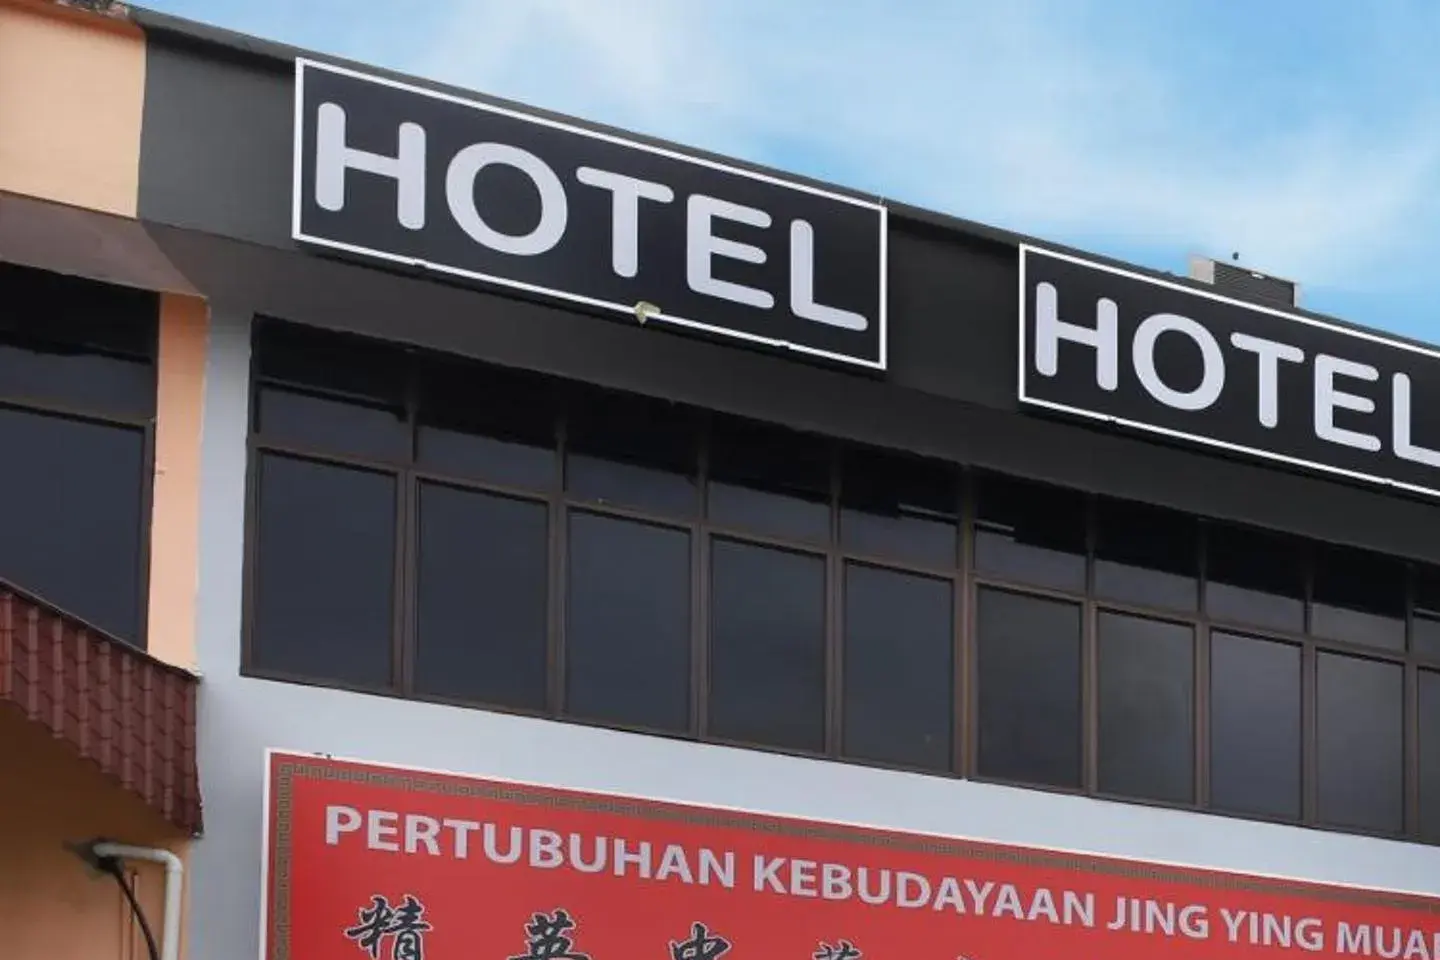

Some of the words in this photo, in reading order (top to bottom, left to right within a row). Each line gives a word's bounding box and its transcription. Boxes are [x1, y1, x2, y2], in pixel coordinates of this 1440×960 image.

[315, 102, 868, 331] HOTEL
[324, 804, 735, 889] PERTUBUHAN
[753, 855, 1096, 928] KEBUDAYAAN
[1106, 896, 1210, 940] JING
[1219, 908, 1325, 953] YING
